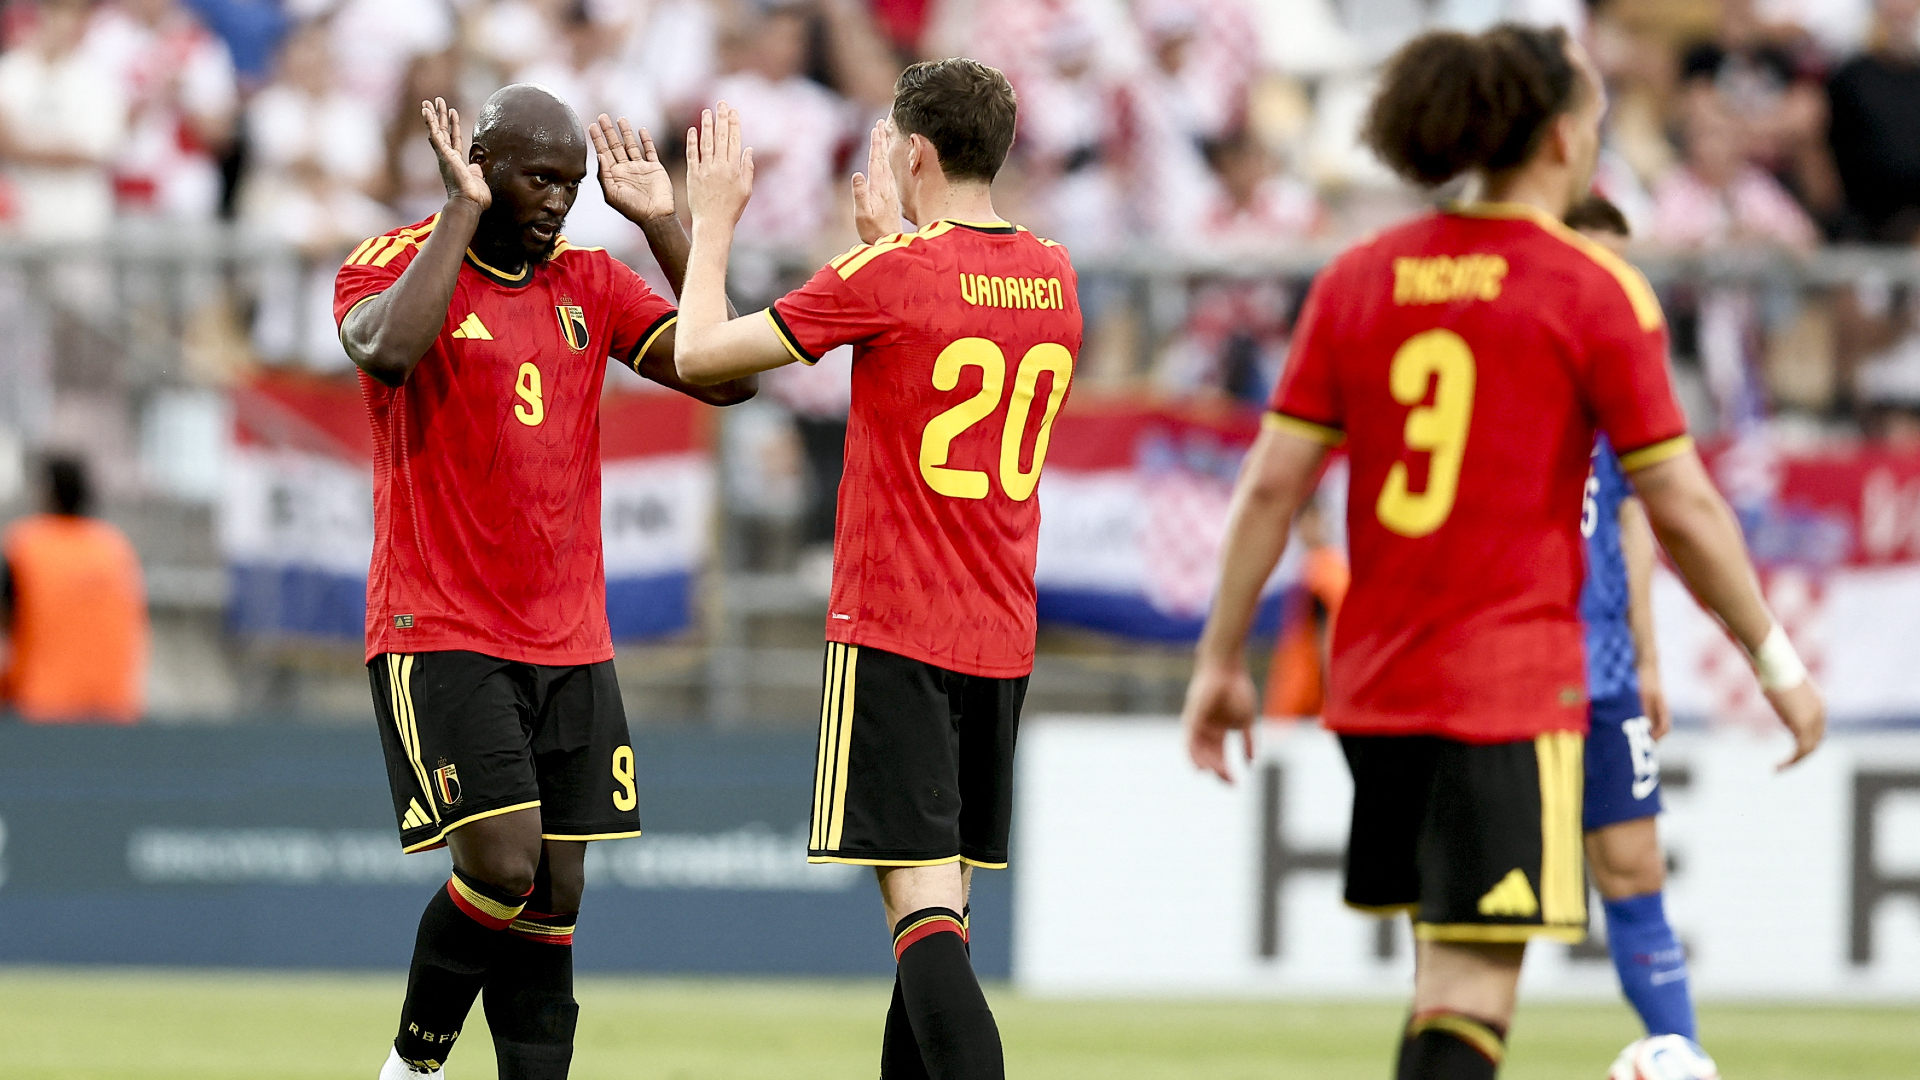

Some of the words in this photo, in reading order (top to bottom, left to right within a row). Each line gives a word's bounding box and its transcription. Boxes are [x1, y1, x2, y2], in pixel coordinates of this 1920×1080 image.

[959, 272, 1064, 310] VANAKEN
[514, 361, 545, 427] 9
[919, 336, 1073, 502] 20
[1375, 327, 1477, 539] 3
[612, 745, 637, 812] 9
[408, 1021, 459, 1044] RBFA
